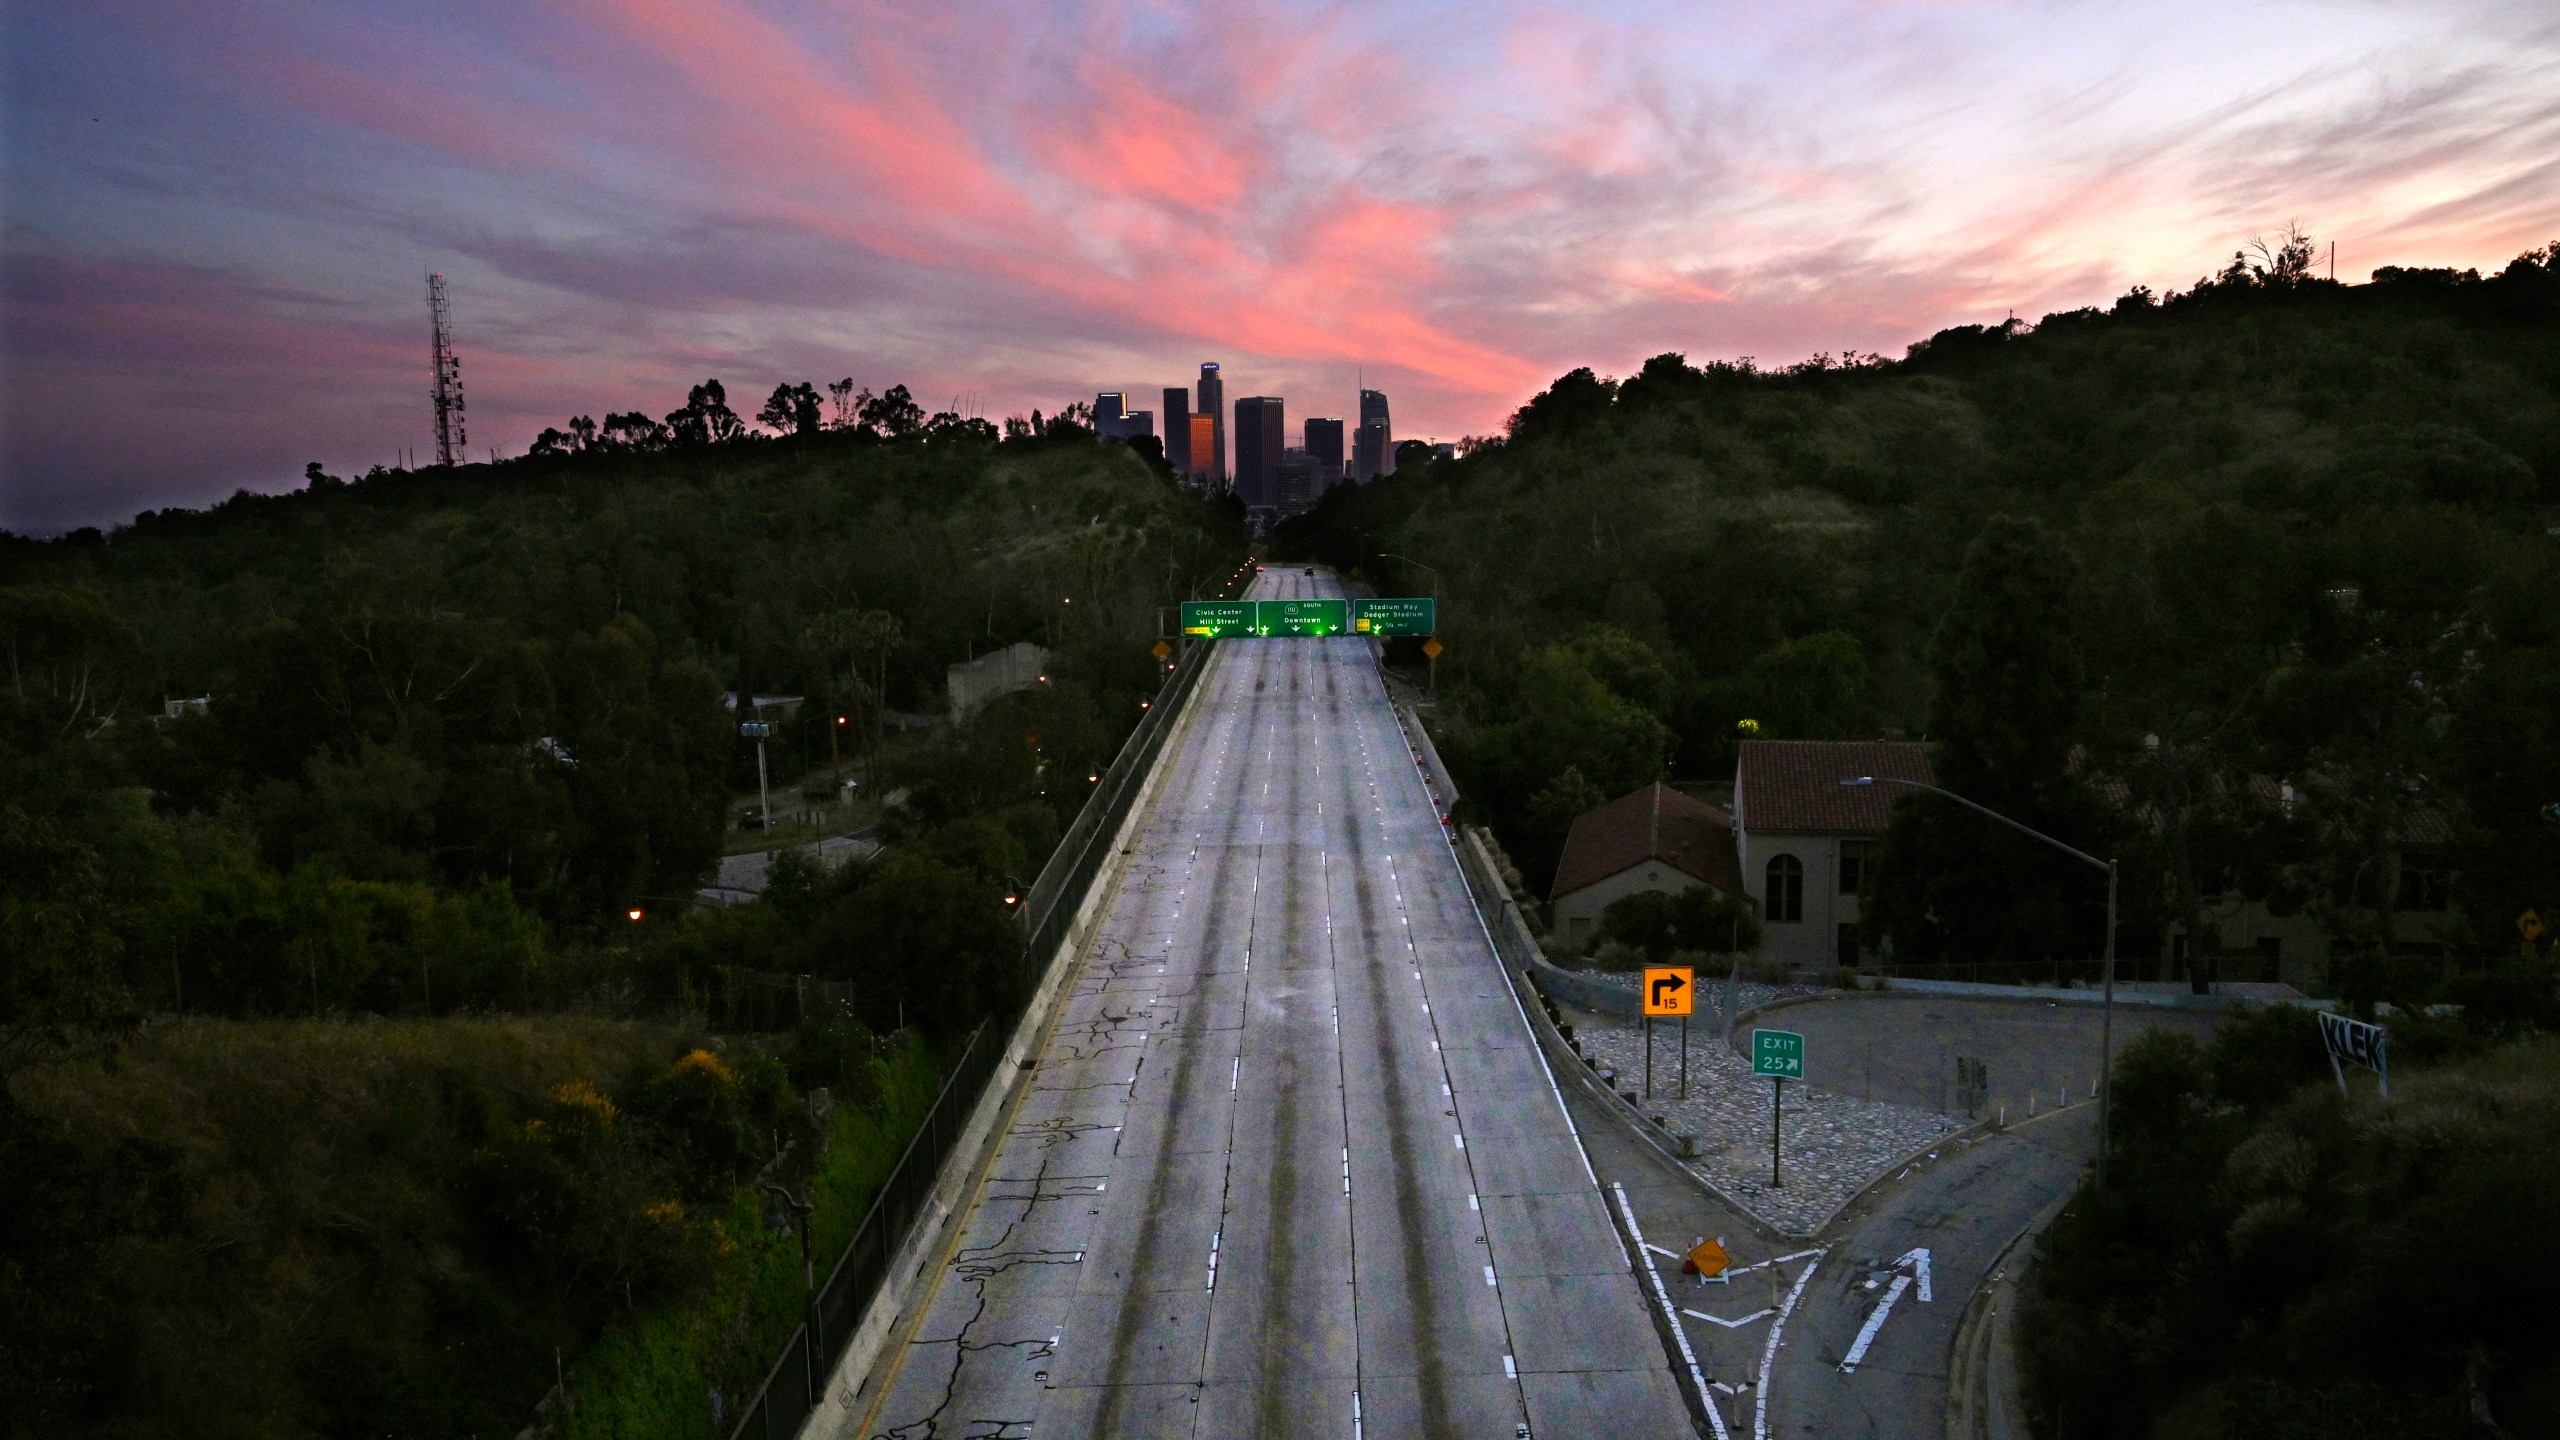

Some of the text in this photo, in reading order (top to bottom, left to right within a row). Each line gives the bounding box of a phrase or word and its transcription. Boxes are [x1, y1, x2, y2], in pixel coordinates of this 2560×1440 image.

[1664, 998, 1678, 1009] 15
[1763, 1038, 1796, 1051] EXIT
[1764, 1056, 1784, 1070] 25
